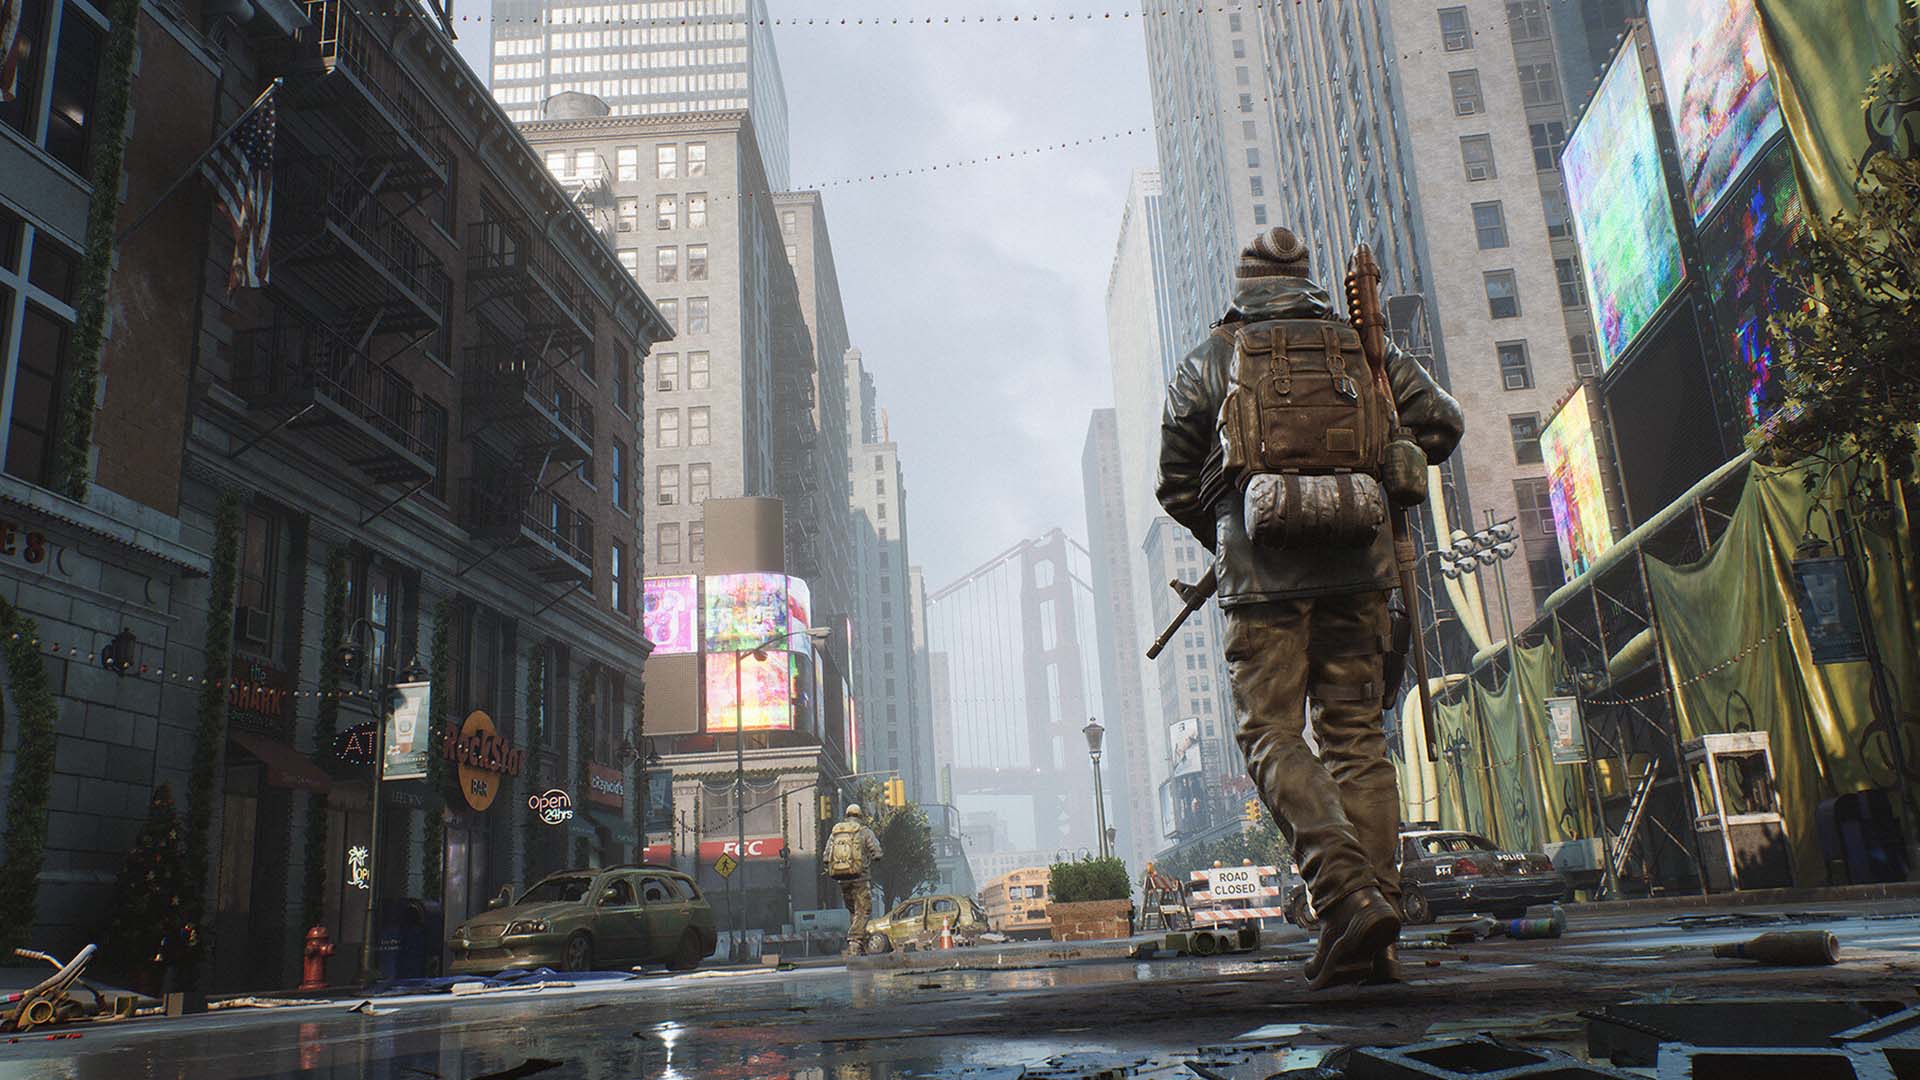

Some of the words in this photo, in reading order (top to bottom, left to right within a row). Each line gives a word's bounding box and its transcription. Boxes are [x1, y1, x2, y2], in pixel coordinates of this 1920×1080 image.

[342, 731, 378, 756] AT
[471, 778, 489, 797] BAR
[528, 795, 569, 813] Open
[544, 808, 574, 821] 24hrs
[1496, 853, 1527, 862] POLICE
[356, 867, 370, 881] OP
[1219, 871, 1249, 883] ROAD
[1214, 883, 1257, 896] CLOSED
